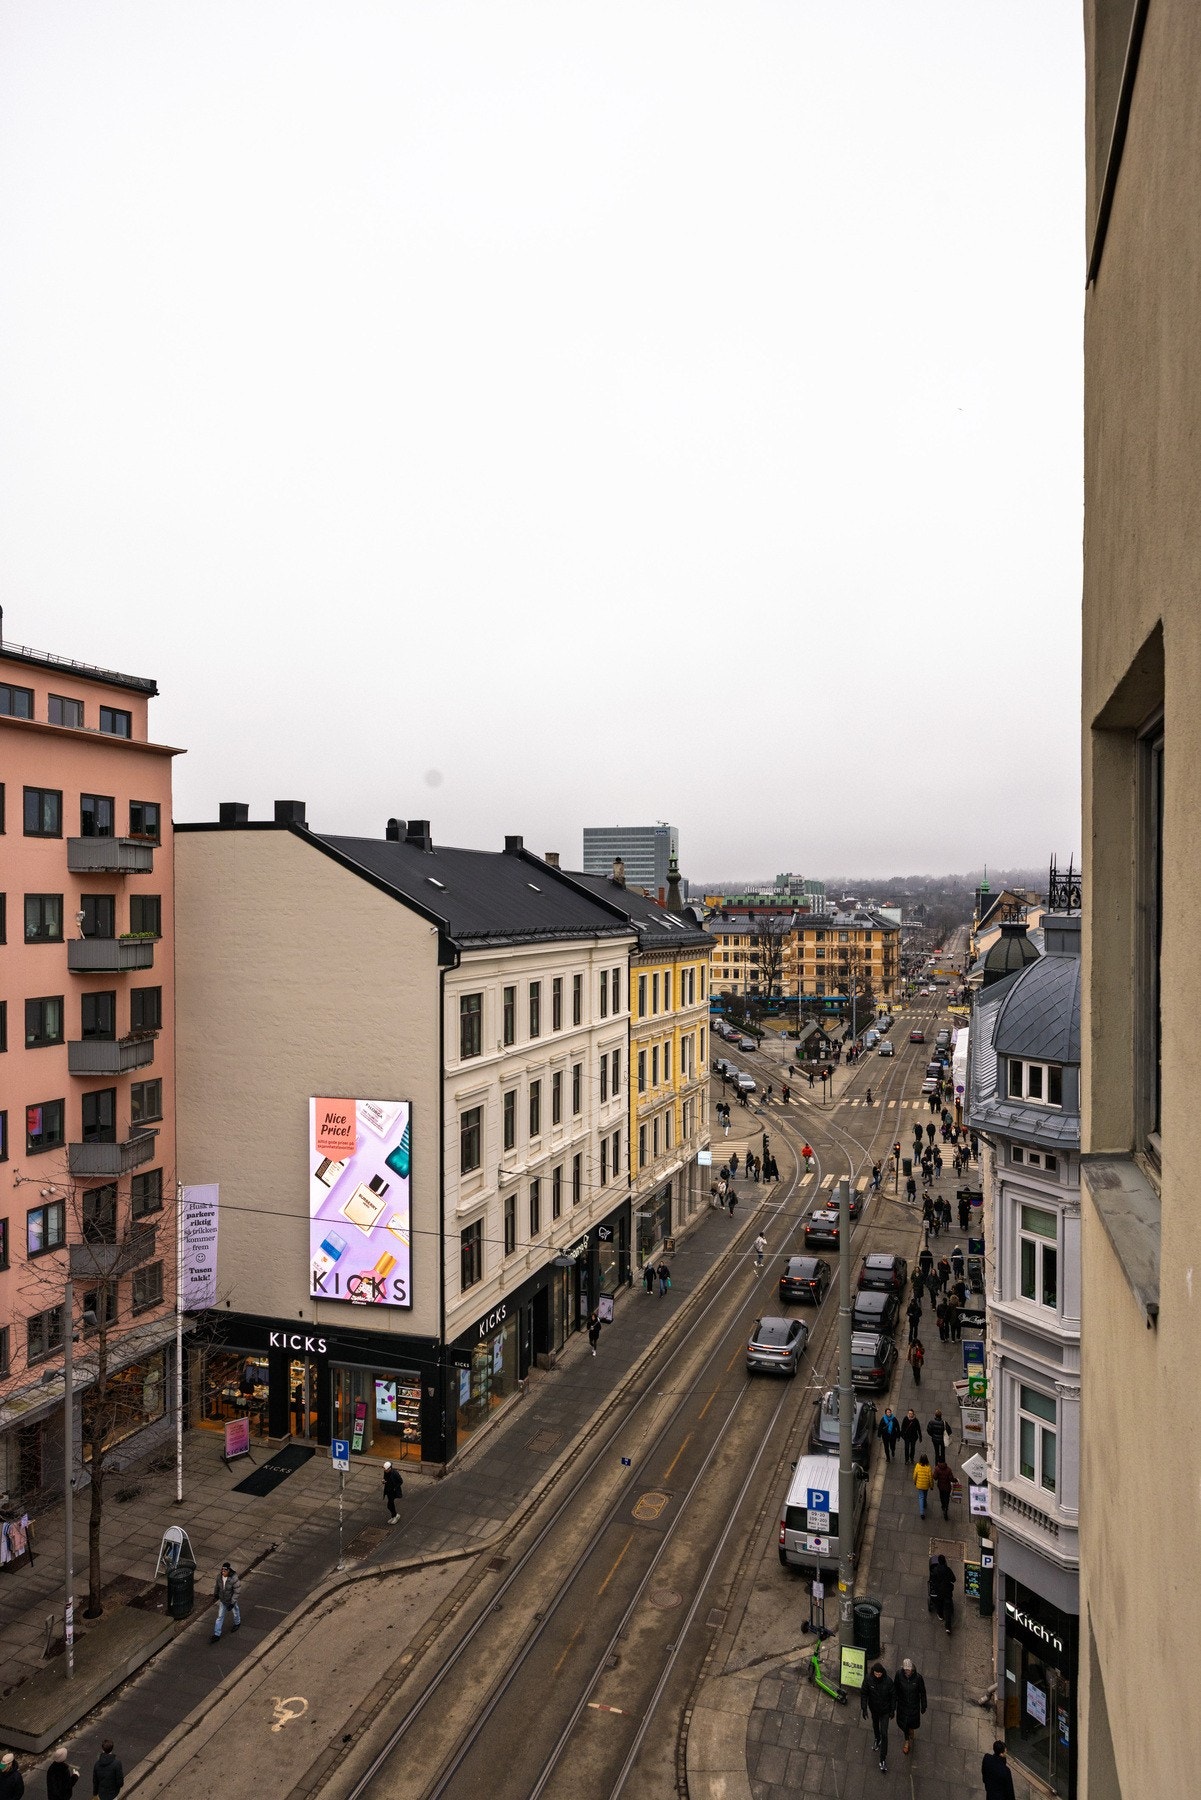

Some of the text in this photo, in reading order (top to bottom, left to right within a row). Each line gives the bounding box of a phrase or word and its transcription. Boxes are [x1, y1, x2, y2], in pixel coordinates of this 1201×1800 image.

[324, 1113, 347, 1125] Nice
[320, 1124, 352, 1137] Price!
[189, 1202, 207, 1211] Husk
[186, 1211, 215, 1220] parkere
[190, 1219, 212, 1227] riktig
[185, 1235, 216, 1243] kommer
[190, 1274, 211, 1282] takk!
[313, 1270, 407, 1302] KICKS
[479, 1304, 507, 1338] KICKS
[269, 1331, 327, 1354] KICKS
[335, 1442, 345, 1457] P
[263, 1464, 293, 1475] KICKS
[812, 1491, 824, 1508] P
[984, 1557, 992, 1566] P
